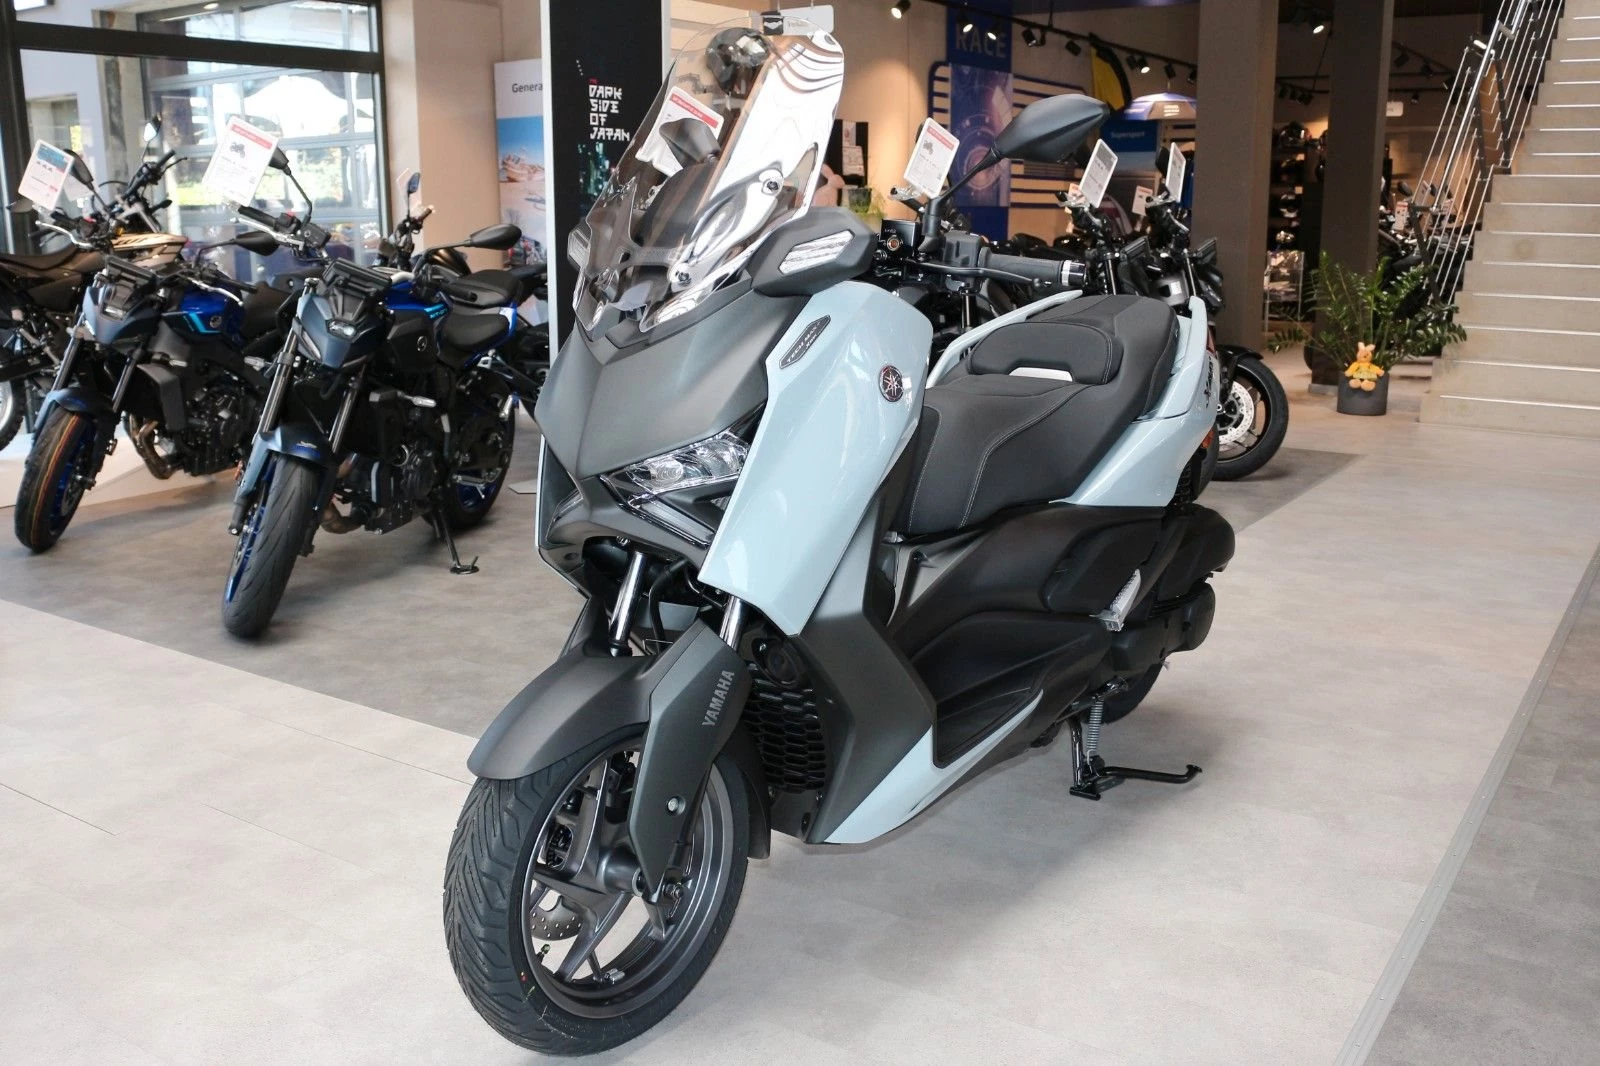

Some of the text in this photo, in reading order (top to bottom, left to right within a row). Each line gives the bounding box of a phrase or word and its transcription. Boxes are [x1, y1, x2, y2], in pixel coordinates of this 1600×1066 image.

[955, 23, 1006, 58] RACE
[589, 85, 622, 100] DARK
[590, 99, 619, 113] SIDE
[590, 113, 607, 126] OF
[590, 127, 630, 141] JAPAN
[702, 670, 735, 726] YAMAHA
